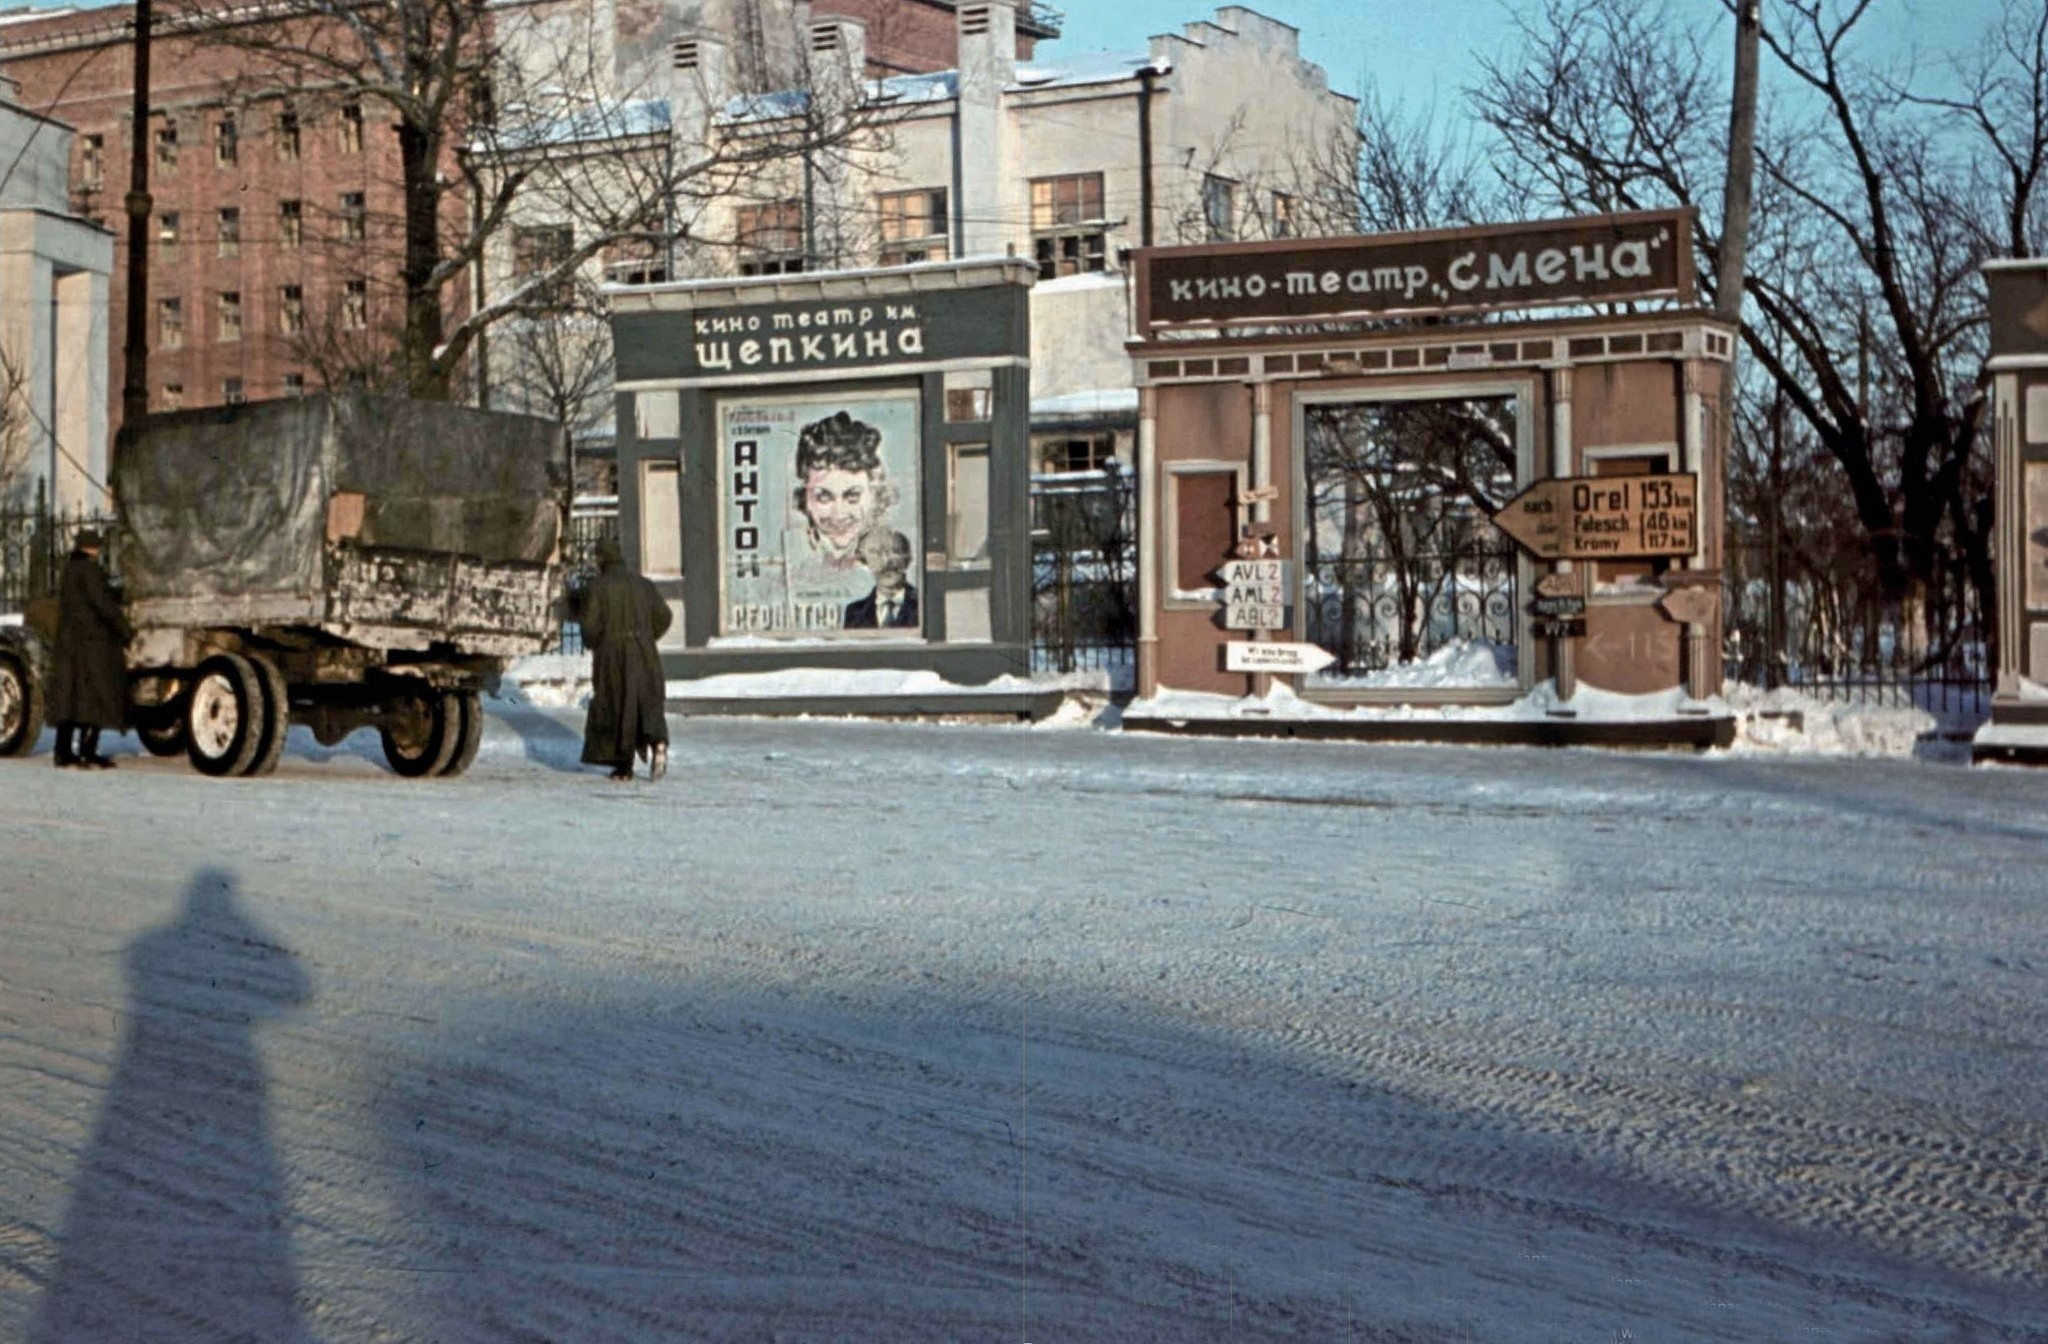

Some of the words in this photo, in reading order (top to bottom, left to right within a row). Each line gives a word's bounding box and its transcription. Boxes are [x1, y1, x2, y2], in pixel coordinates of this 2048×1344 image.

[695, 315, 760, 334] кино
[773, 307, 873, 326] театр
[1573, 483, 1629, 511] Orel
[1641, 481, 1672, 509] 153
[1233, 564, 1265, 581] AVL
[1268, 564, 1279, 581] 2
[1232, 587, 1265, 604] AML
